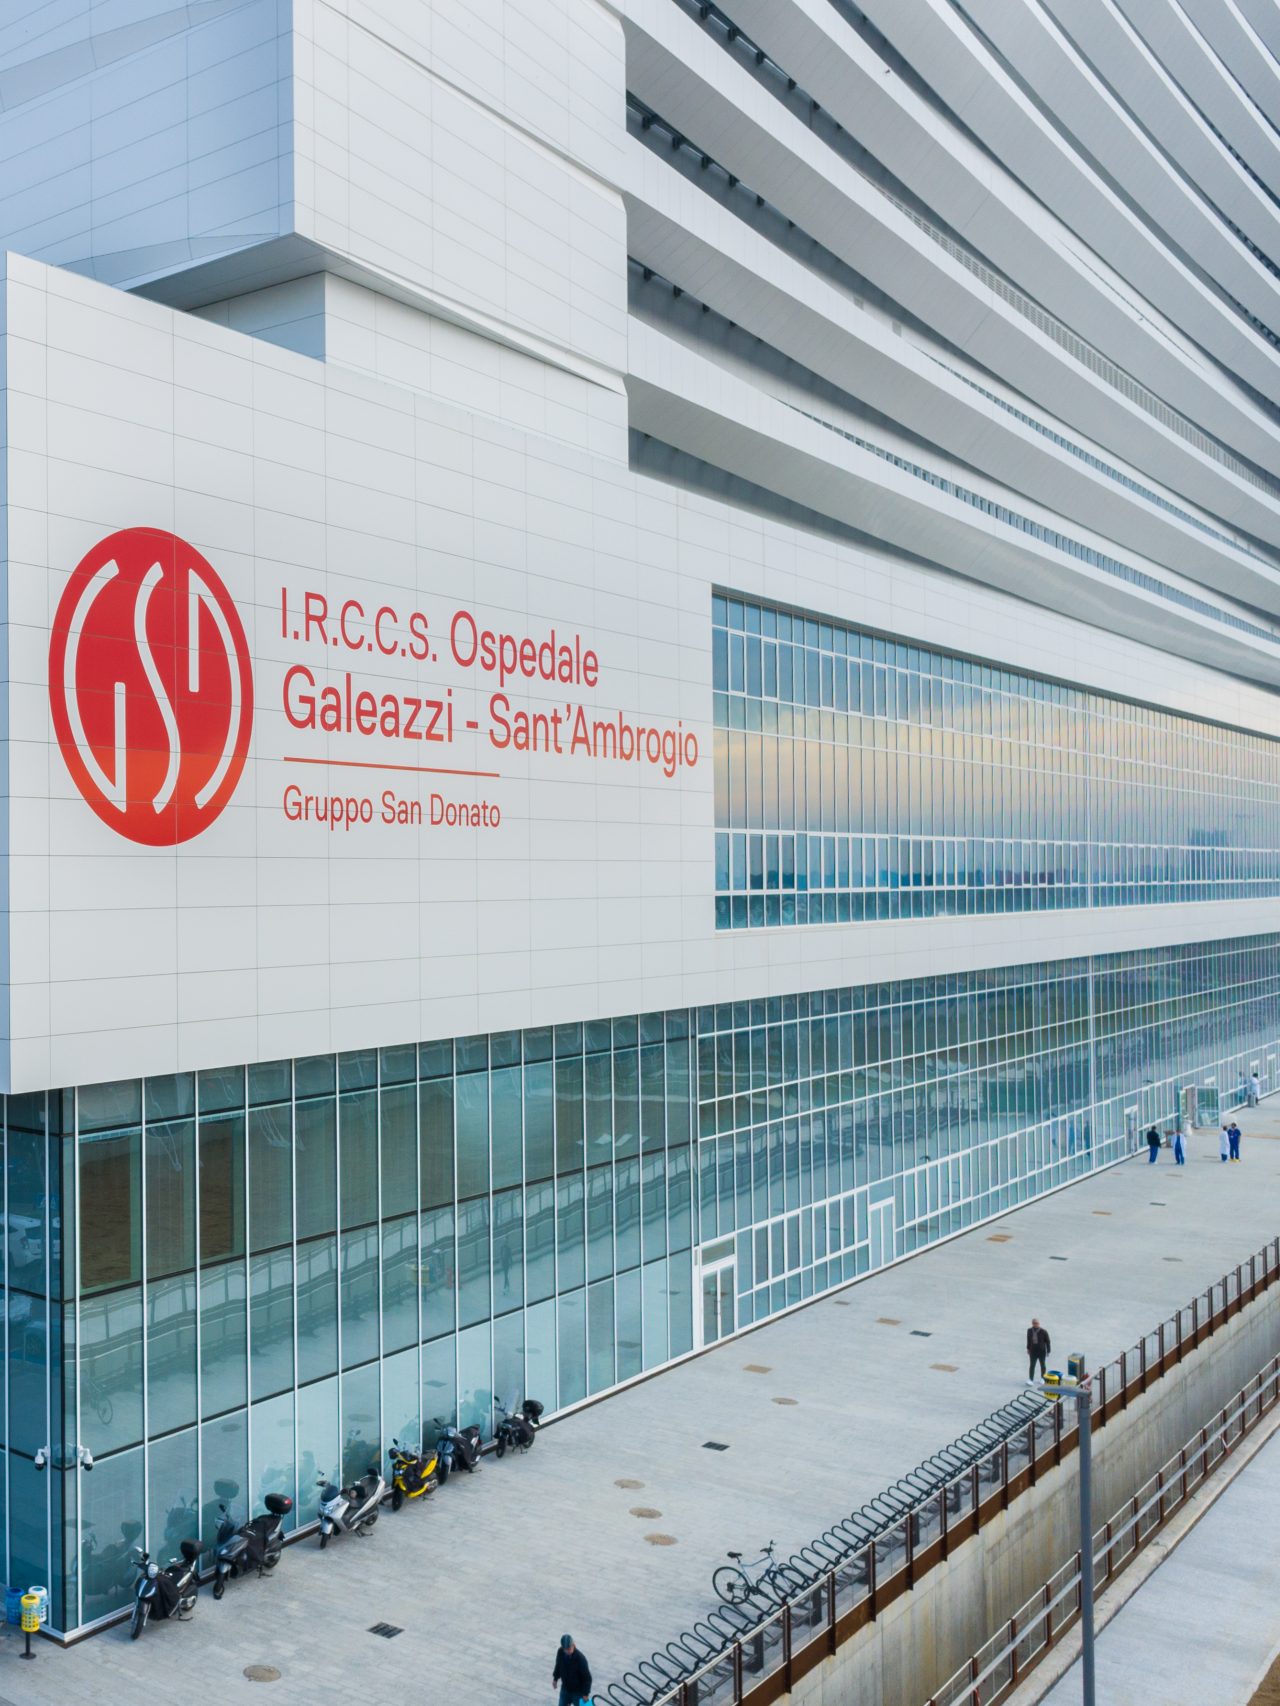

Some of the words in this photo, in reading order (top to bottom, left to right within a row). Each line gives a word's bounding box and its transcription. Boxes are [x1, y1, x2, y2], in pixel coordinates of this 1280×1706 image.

[281, 587, 439, 662] I.R.C.C.S.
[450, 610, 600, 689] Ospedale
[282, 664, 454, 743] Galeazzi
[465, 719, 480, 730] -
[488, 691, 700, 780] Sant'Ambrogio
[283, 783, 374, 831] Gruppo
[381, 789, 423, 826] San
[429, 792, 502, 829] Donato
